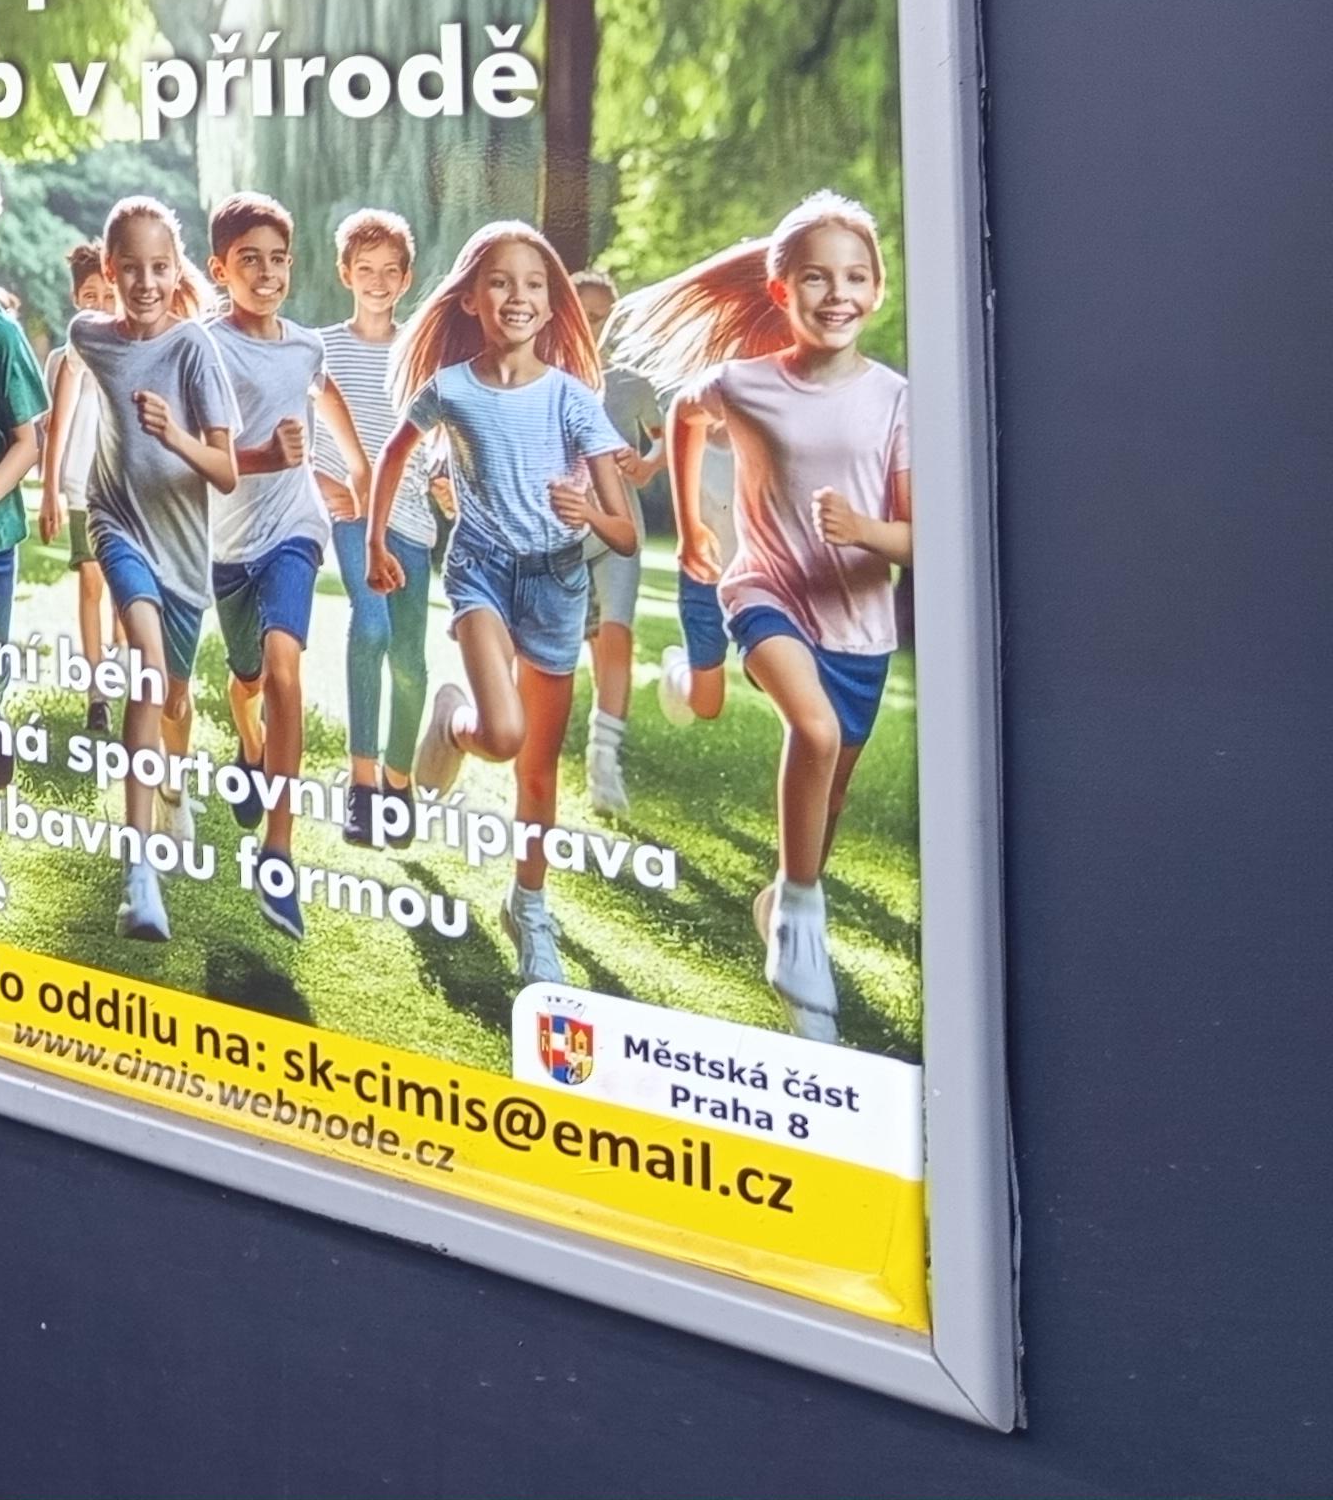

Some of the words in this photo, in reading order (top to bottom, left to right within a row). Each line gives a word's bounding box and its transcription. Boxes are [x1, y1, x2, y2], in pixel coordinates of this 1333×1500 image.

[54, 61, 106, 116] v
[142, 24, 539, 139] přírodě
[60, 637, 163, 705] běh
[68, 733, 349, 826] sportovní
[370, 786, 679, 891] příprava
[236, 834, 468, 939] formou
[13, 1021, 455, 1173] www.cimis.webnode.cz
[39, 980, 176, 1046] oddílu
[195, 1019, 266, 1071] na:
[284, 1041, 793, 1213] sk-cimis@email.cz
[624, 1034, 769, 1093] Městská
[783, 1056, 860, 1113] část
[670, 1084, 774, 1133] Praha
[788, 1114, 810, 1141] 8
